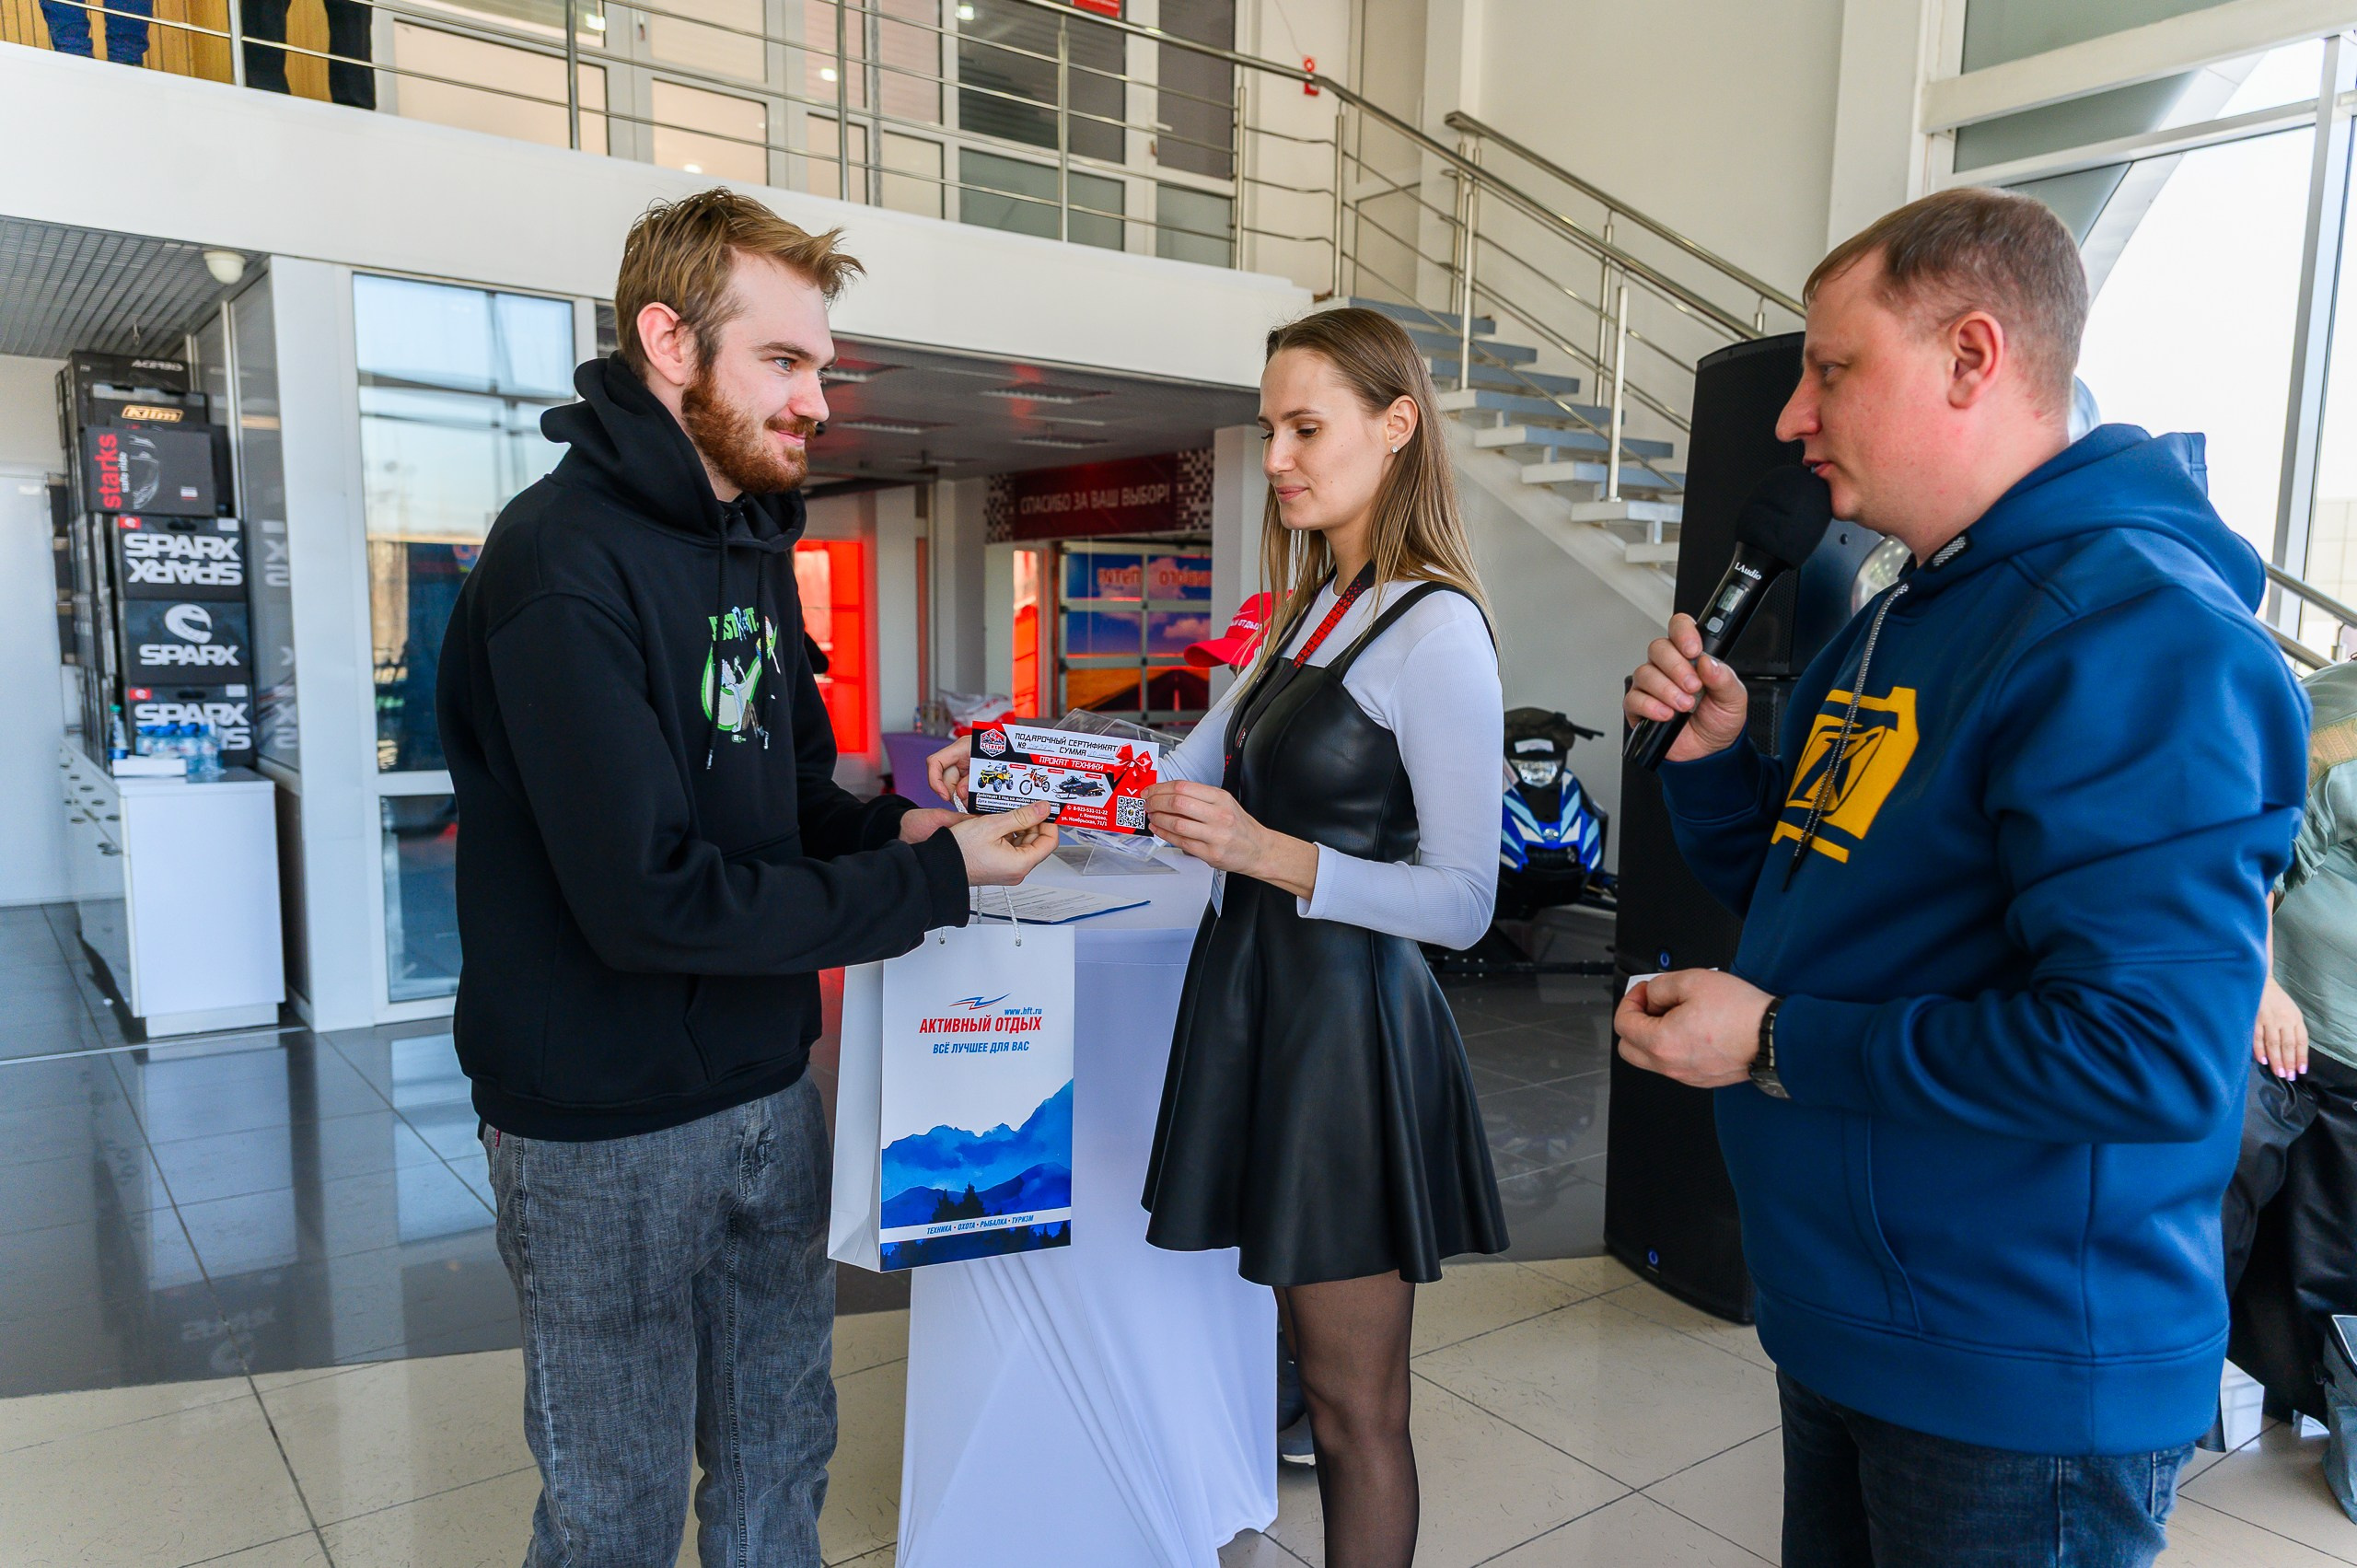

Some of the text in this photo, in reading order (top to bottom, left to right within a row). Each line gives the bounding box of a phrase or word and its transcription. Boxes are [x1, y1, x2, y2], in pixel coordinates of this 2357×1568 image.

[94, 434, 122, 509] starks
[1020, 483, 1170, 515] СПАСИБО ЗА ВАШ ВЫБОР!
[123, 532, 240, 562] SPARX
[126, 558, 243, 586] SPARX
[1734, 562, 1762, 581] LAudio
[139, 644, 240, 667] SPARX
[134, 703, 251, 727] SPARX
[1015, 732, 1067, 746] ПОДАРОЧНЫЙ
[1068, 739, 1118, 752] СЕРТИФИКАТ
[1059, 747, 1086, 757] СУММА
[1039, 756, 1104, 771] ПРОКАТ ТЕХНИКИ
[919, 1015, 1042, 1034] АКТИВНЫЙ ОТДЫХ
[933, 1040, 1030, 1053] ВСЁ ЛУЧШЕЕ ДЛЯ ВАС
[927, 1215, 1033, 1235] ТЕХНИКА ОХОТА РЫБАЛКА ТУРИЗМ
